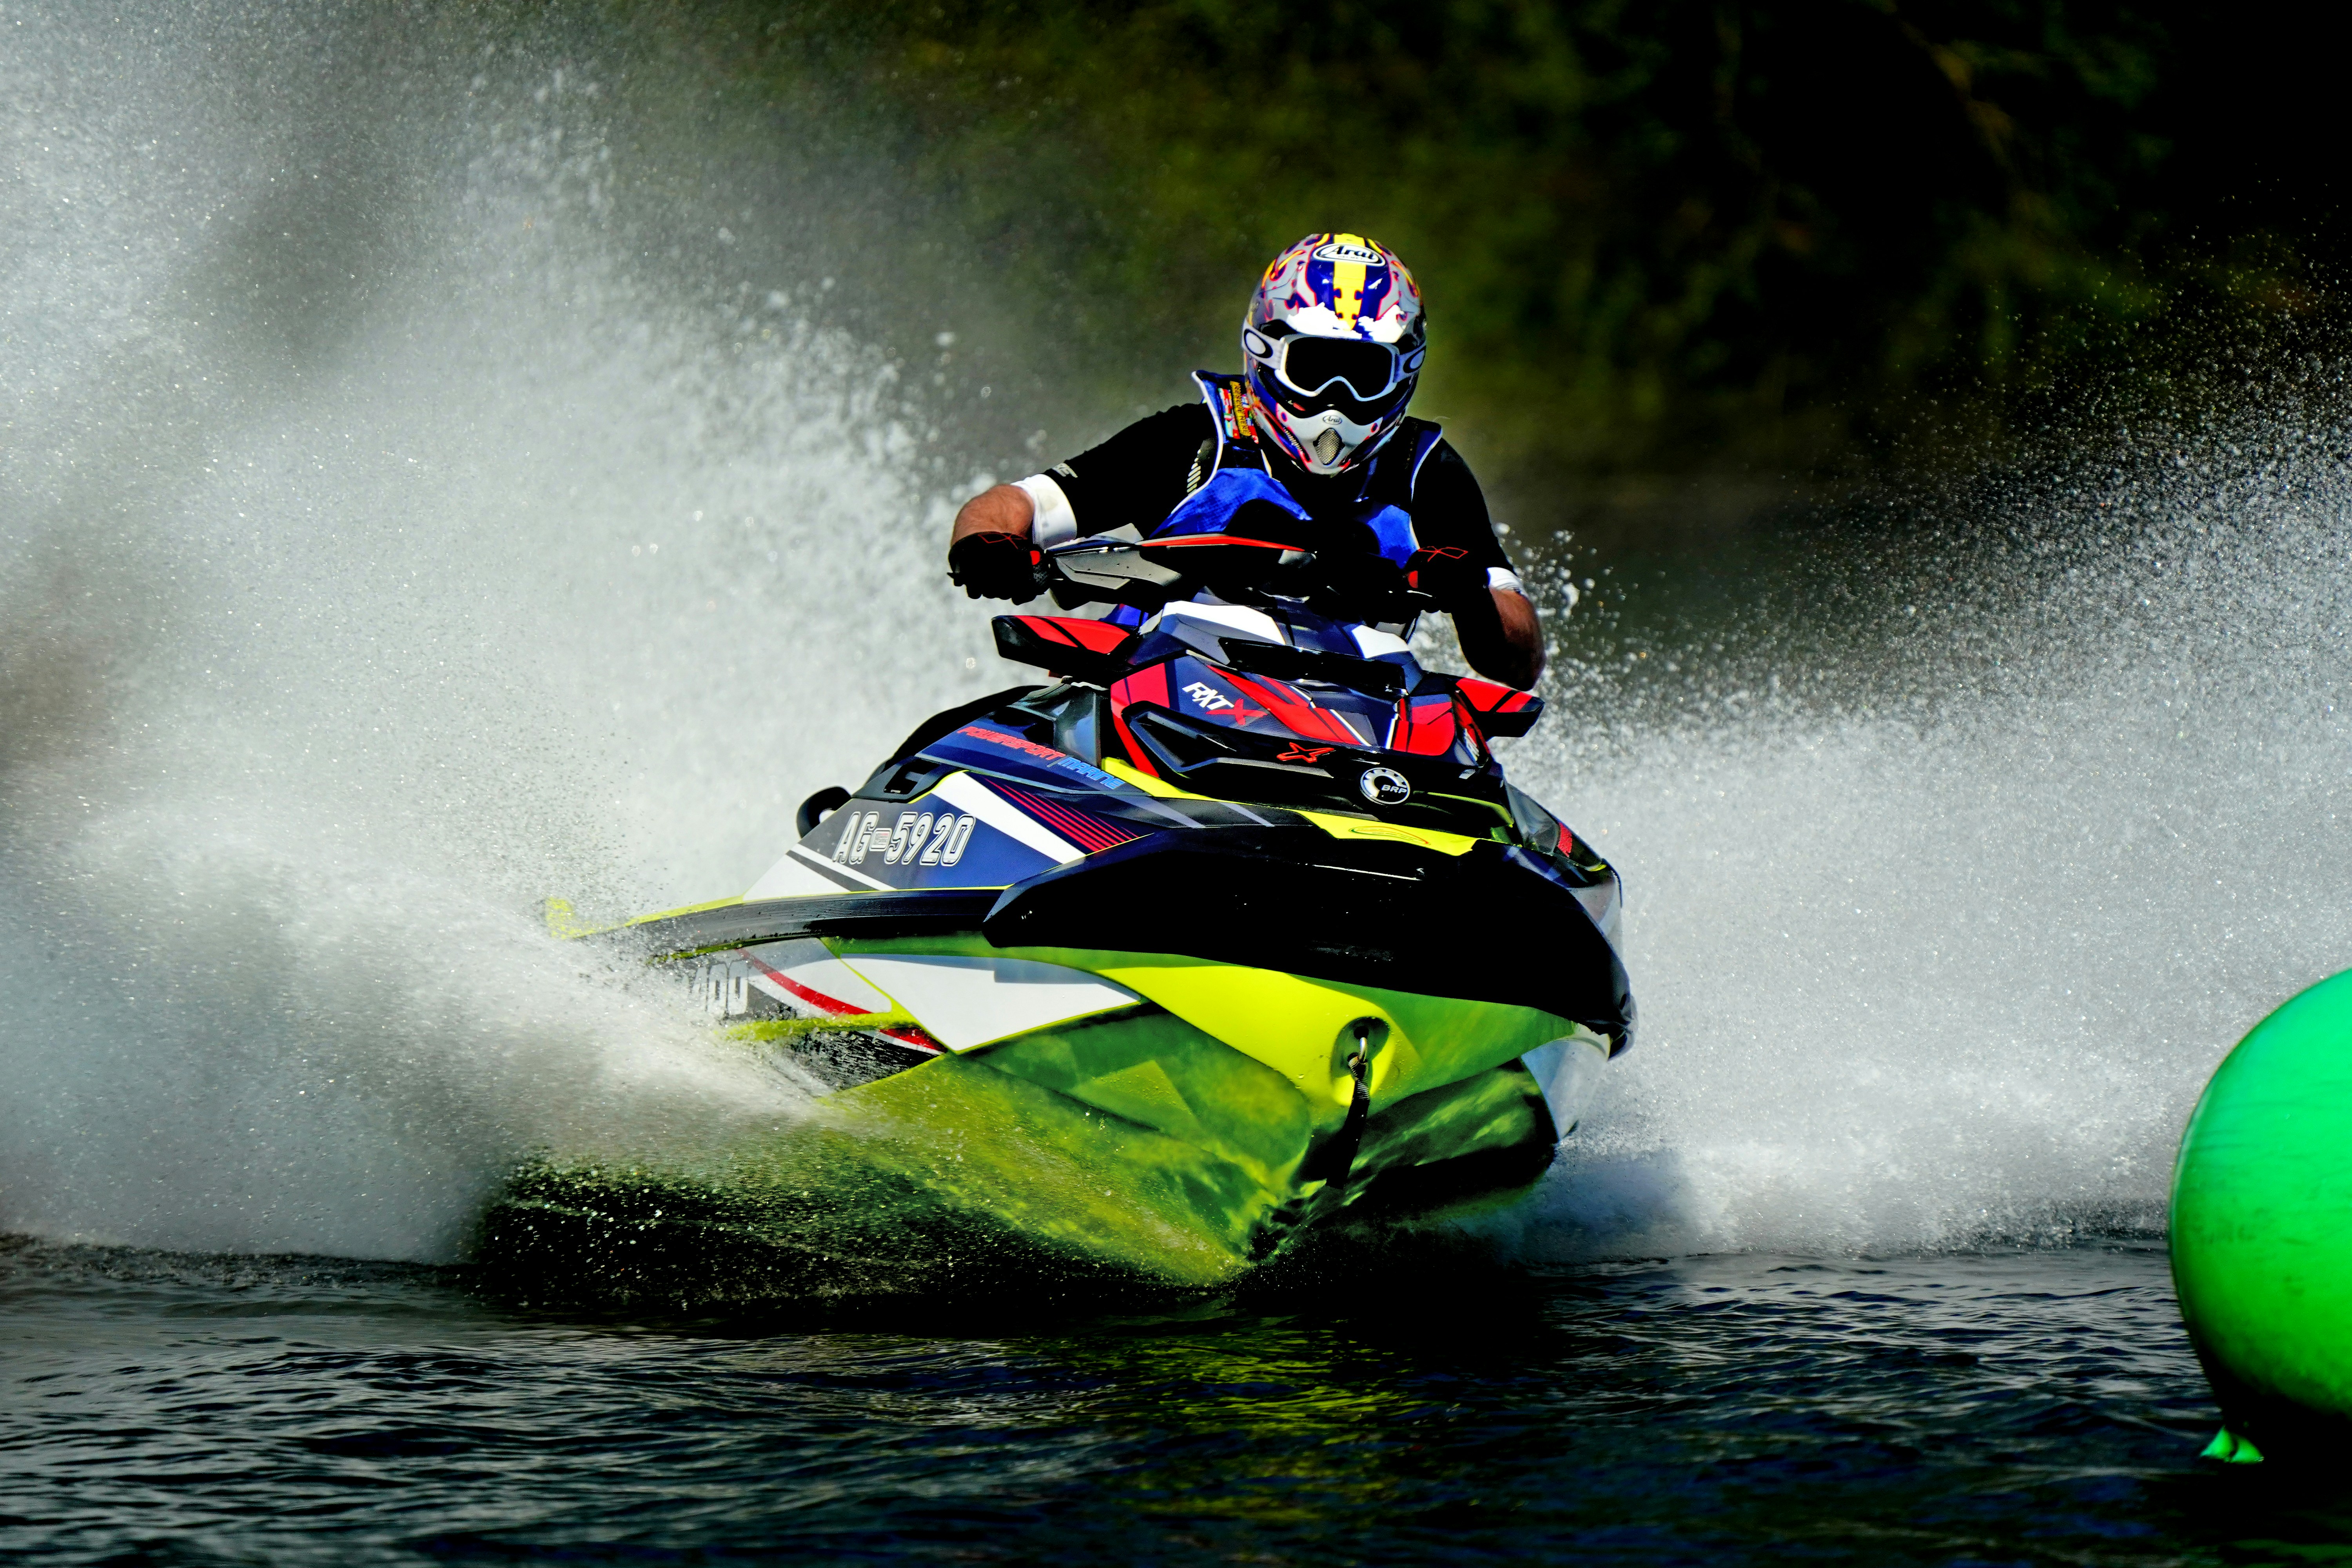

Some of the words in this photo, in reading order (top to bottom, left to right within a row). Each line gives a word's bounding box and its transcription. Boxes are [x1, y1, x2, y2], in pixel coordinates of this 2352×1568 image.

[1320, 245, 1376, 259] Arai
[957, 726, 1066, 760] POWERSPORT
[1057, 756, 1126, 789] MARINE
[1381, 784, 1407, 793] BRP
